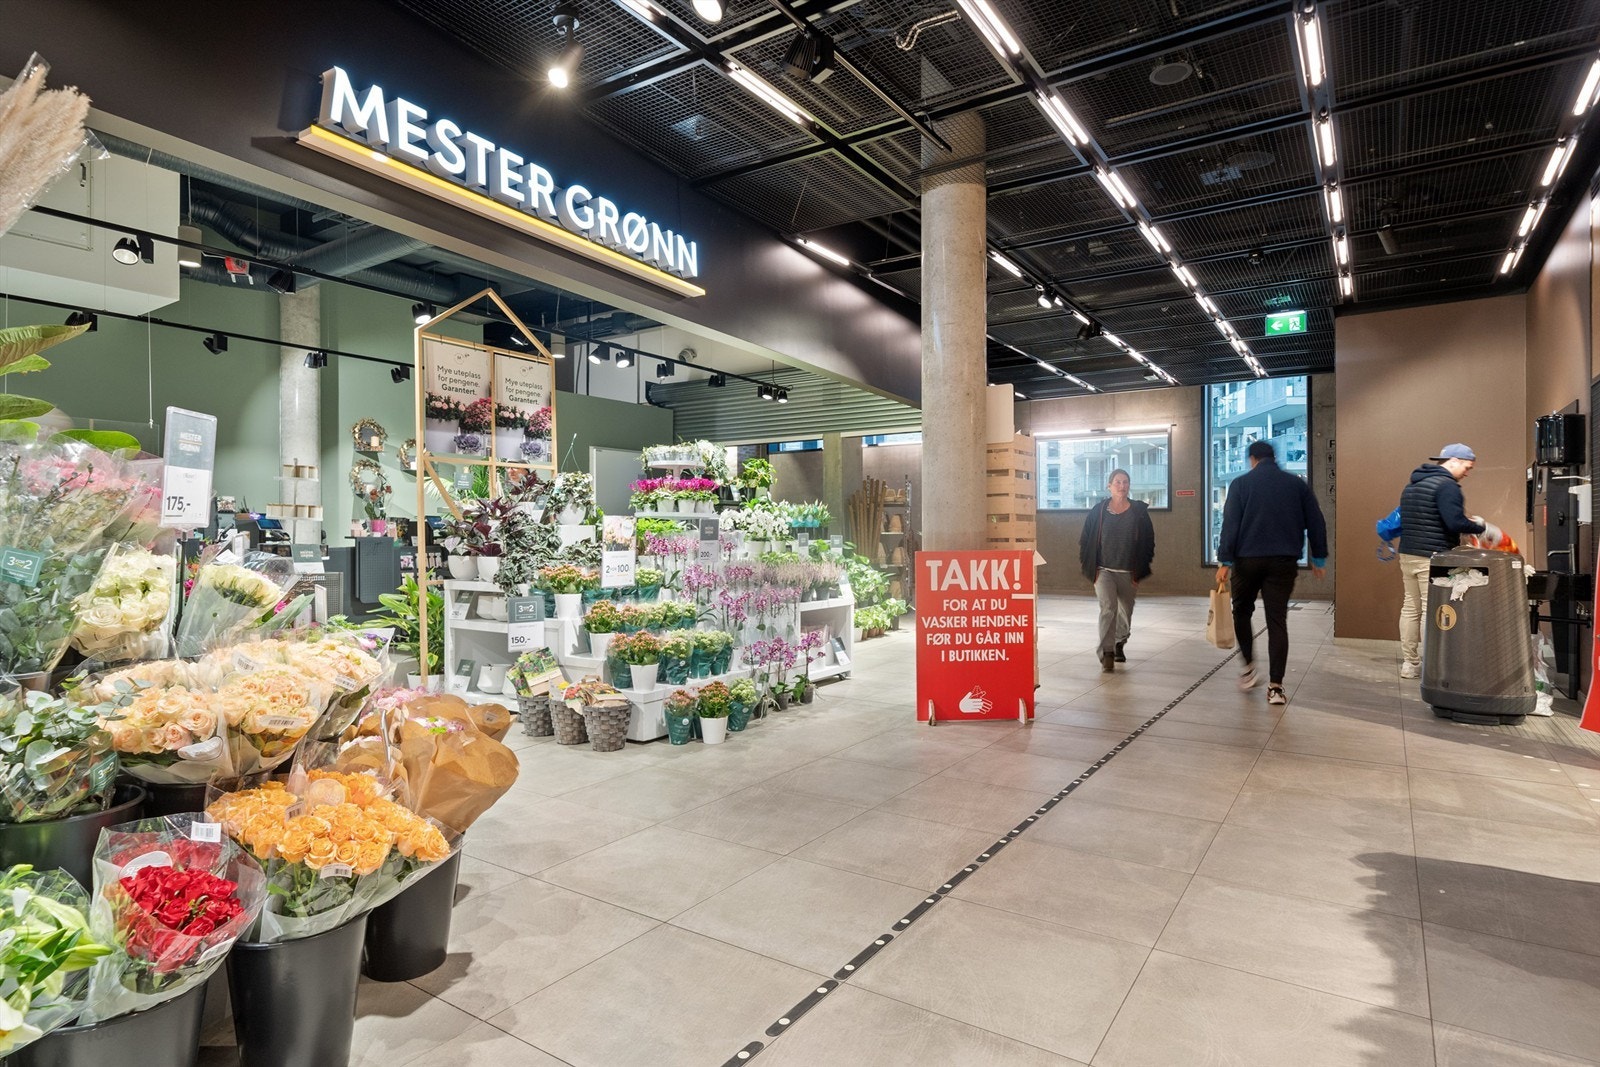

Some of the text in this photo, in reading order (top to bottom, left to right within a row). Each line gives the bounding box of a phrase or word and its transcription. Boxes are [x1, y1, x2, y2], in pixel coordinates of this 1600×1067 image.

[330, 65, 699, 278] MESTER GRØNN
[437, 365, 481, 380] Mye uteplass
[437, 374, 480, 388] for pengene.
[505, 378, 543, 391] Mye uteplass
[441, 384, 477, 395] Garantert.
[508, 395, 540, 405] Garantert.
[166, 495, 191, 513] 175,-
[926, 559, 1022, 591] TAKK!
[943, 599, 1007, 611] FOR AT DU
[921, 615, 1029, 629] VASKER HENDENE
[511, 635, 531, 644] 150,-
[926, 630, 1024, 646] FØR DU GÅR INN
[941, 649, 1010, 662] I BUTIKKEN.
